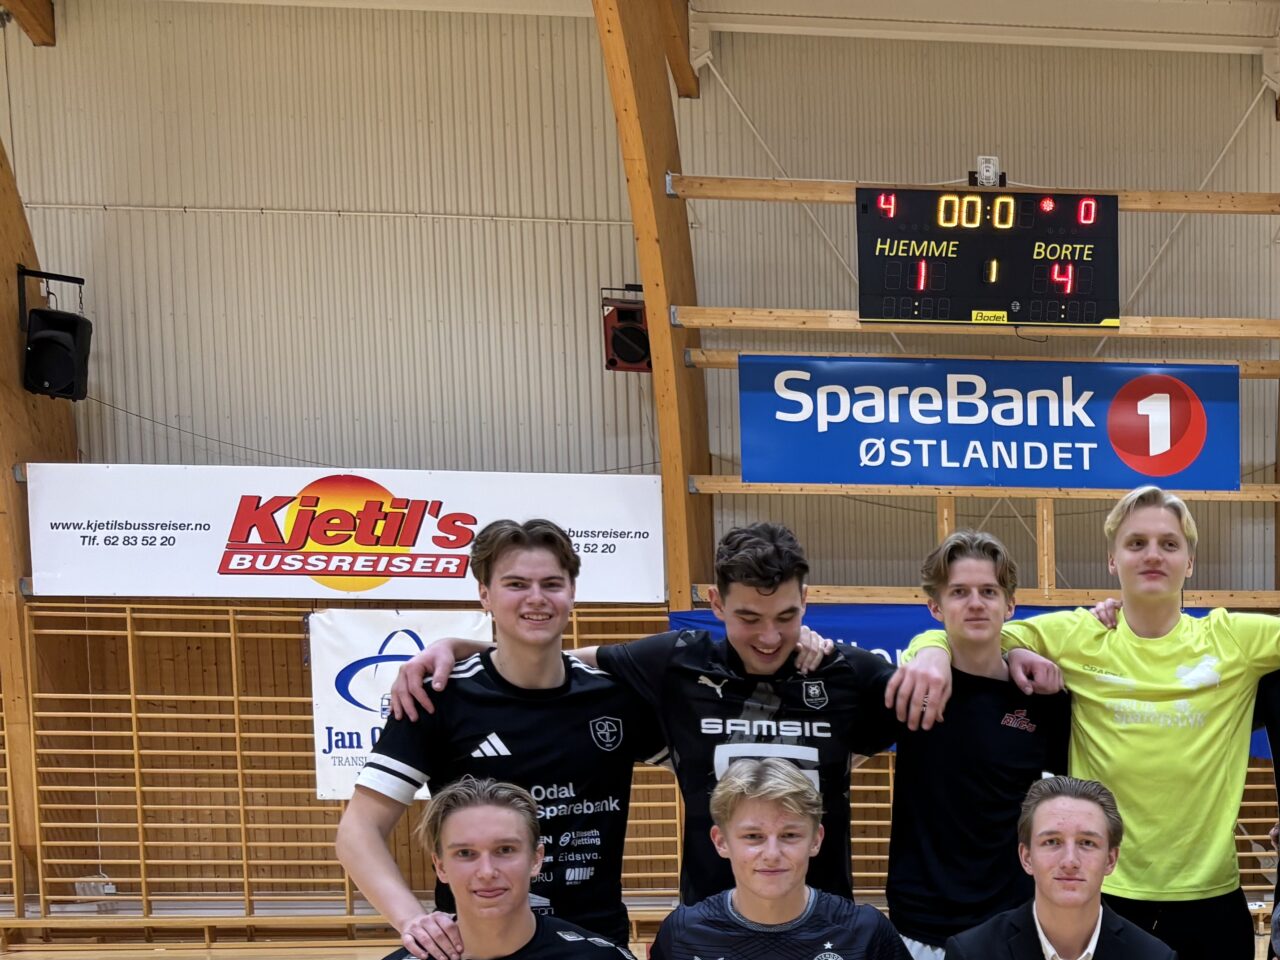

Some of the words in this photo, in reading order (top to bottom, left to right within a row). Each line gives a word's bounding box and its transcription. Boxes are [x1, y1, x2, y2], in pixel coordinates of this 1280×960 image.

[877, 193, 896, 218] 4
[1079, 198, 1097, 225] 0
[875, 238, 959, 257] HJEMME
[1032, 242, 1094, 261] BORTE
[1051, 263, 1073, 294] 4
[974, 312, 1006, 322] Bodet
[773, 369, 1097, 432] SpareBank
[859, 438, 1098, 471] ØSTLANDET
[50, 520, 211, 532] www.kjetilsbussreiser.no
[226, 495, 478, 550] Kjetil's
[80, 535, 99, 546] Tlf.
[103, 536, 119, 546] 62
[122, 536, 138, 546] 83
[141, 536, 157, 546] 52
[160, 536, 176, 546] 20
[566, 528, 650, 539] bussreiser.no
[583, 543, 598, 553] 52
[601, 543, 616, 553] 20
[228, 553, 461, 573] BUSSREISER
[700, 718, 832, 738] SAMSIC
[322, 726, 363, 754] Jan
[531, 782, 576, 801] Odal
[536, 796, 620, 820] Sparebank
